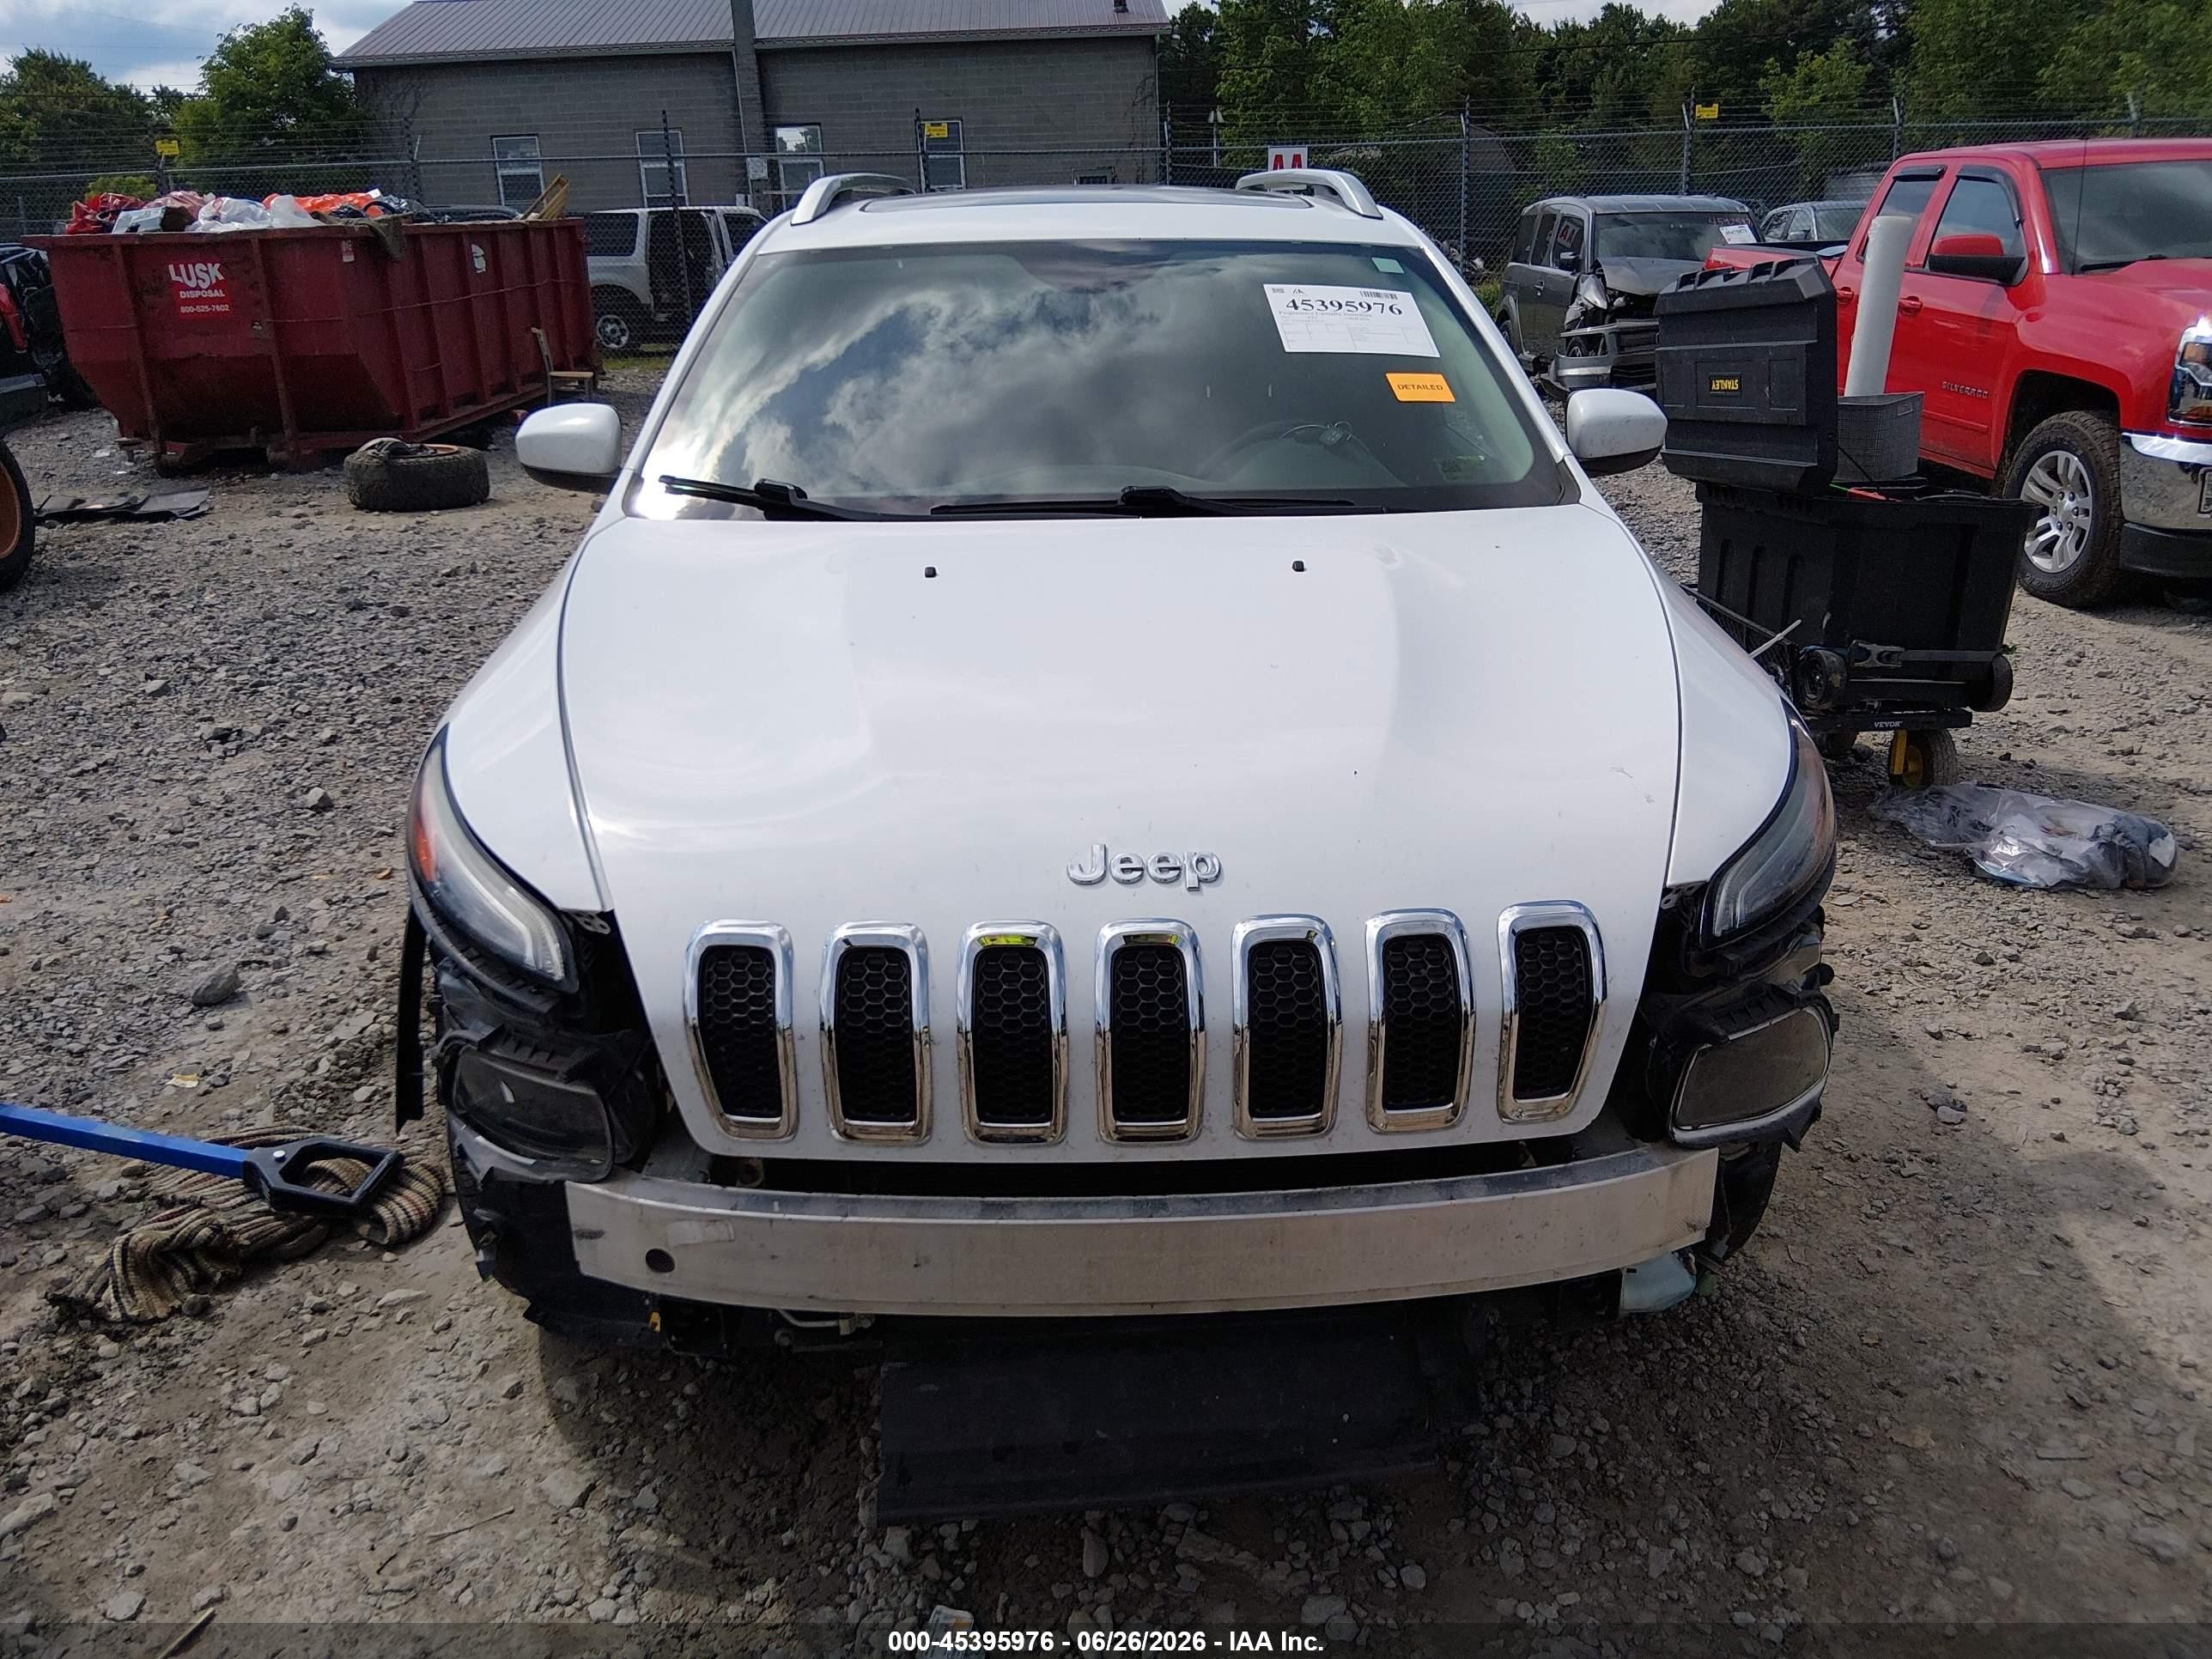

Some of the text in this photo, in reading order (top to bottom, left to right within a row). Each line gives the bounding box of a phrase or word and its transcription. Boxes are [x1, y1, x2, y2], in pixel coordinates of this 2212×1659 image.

[168, 263, 225, 289] LUSK
[179, 289, 226, 299] DISPOSAL
[1286, 299, 1403, 316] 45395976
[1711, 379, 1739, 390] STANLEY
[1066, 843, 1222, 892] Jeep
